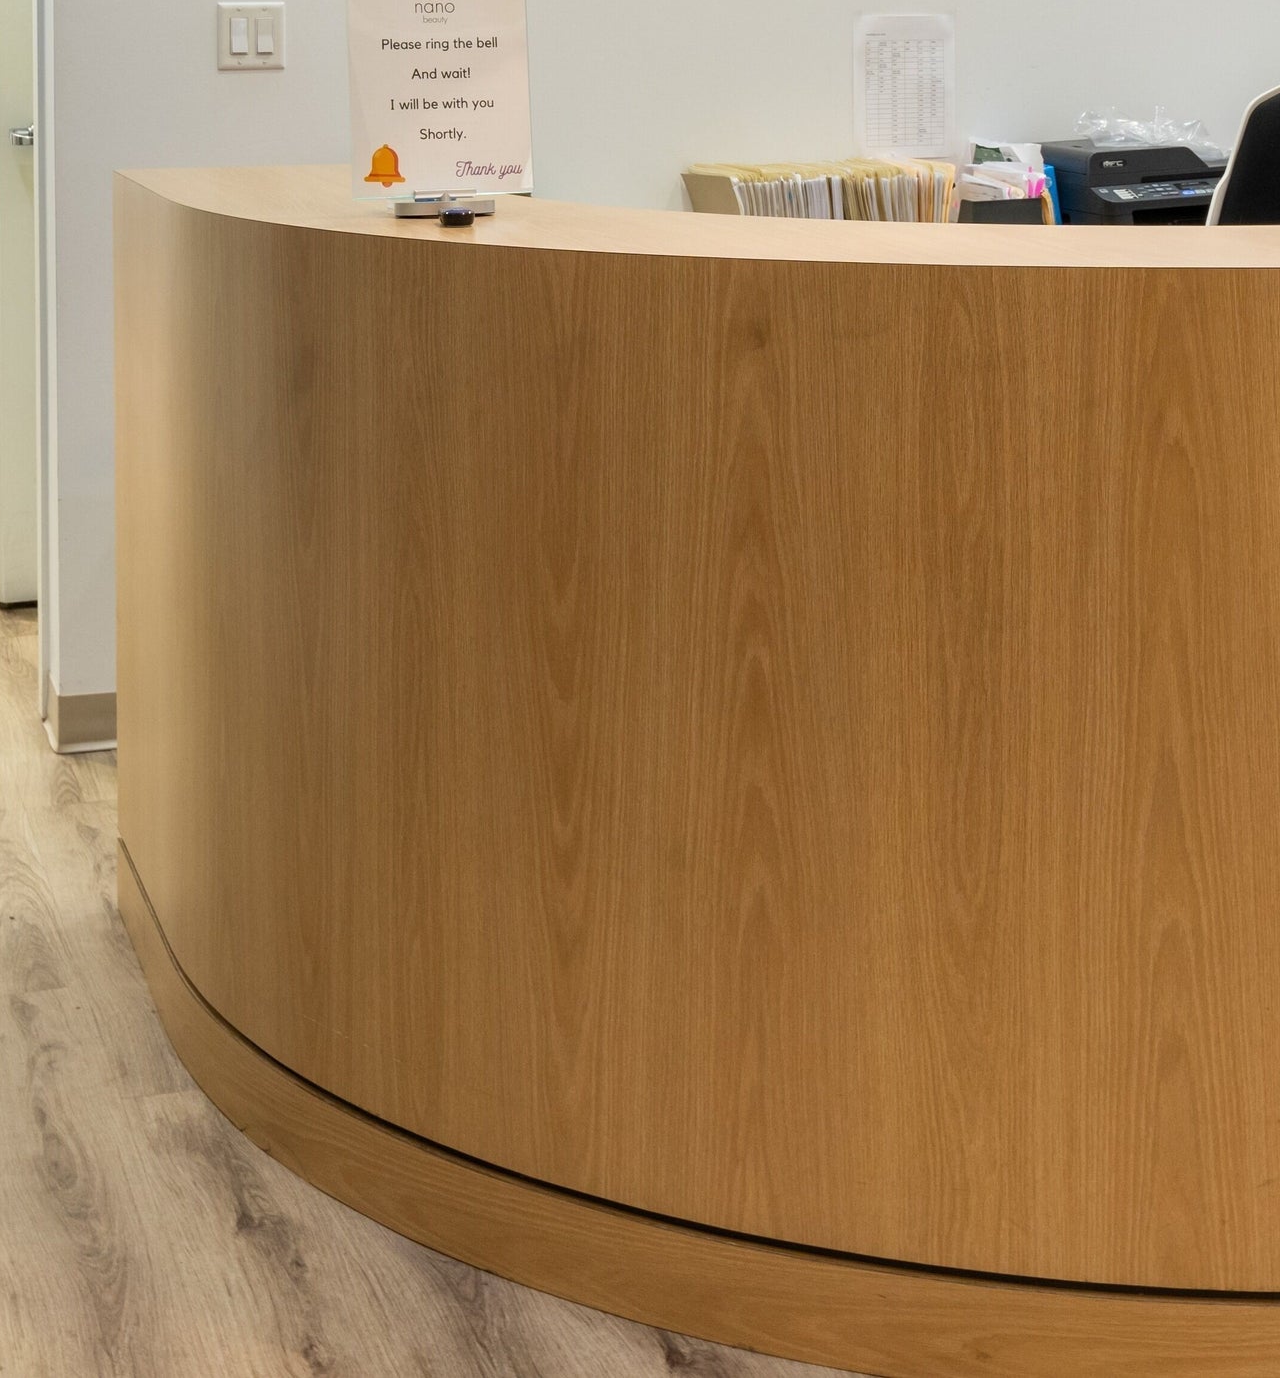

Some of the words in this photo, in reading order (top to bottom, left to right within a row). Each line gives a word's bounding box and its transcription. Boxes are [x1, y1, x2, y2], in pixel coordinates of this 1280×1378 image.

[414, 1, 455, 14] nano
[423, 15, 448, 24] beauty
[381, 38, 421, 50] Please
[425, 39, 449, 51] ring
[453, 38, 473, 49] the
[476, 37, 498, 48] bell
[411, 68, 437, 80] And
[441, 68, 471, 79] wait!
[390, 99, 395, 110] I
[399, 98, 419, 110] will
[423, 98, 439, 109] be
[442, 97, 468, 109] with
[472, 99, 494, 110] you
[419, 128, 467, 141] Shortly.
[456, 161, 496, 177] Thank
[499, 164, 523, 179] you
